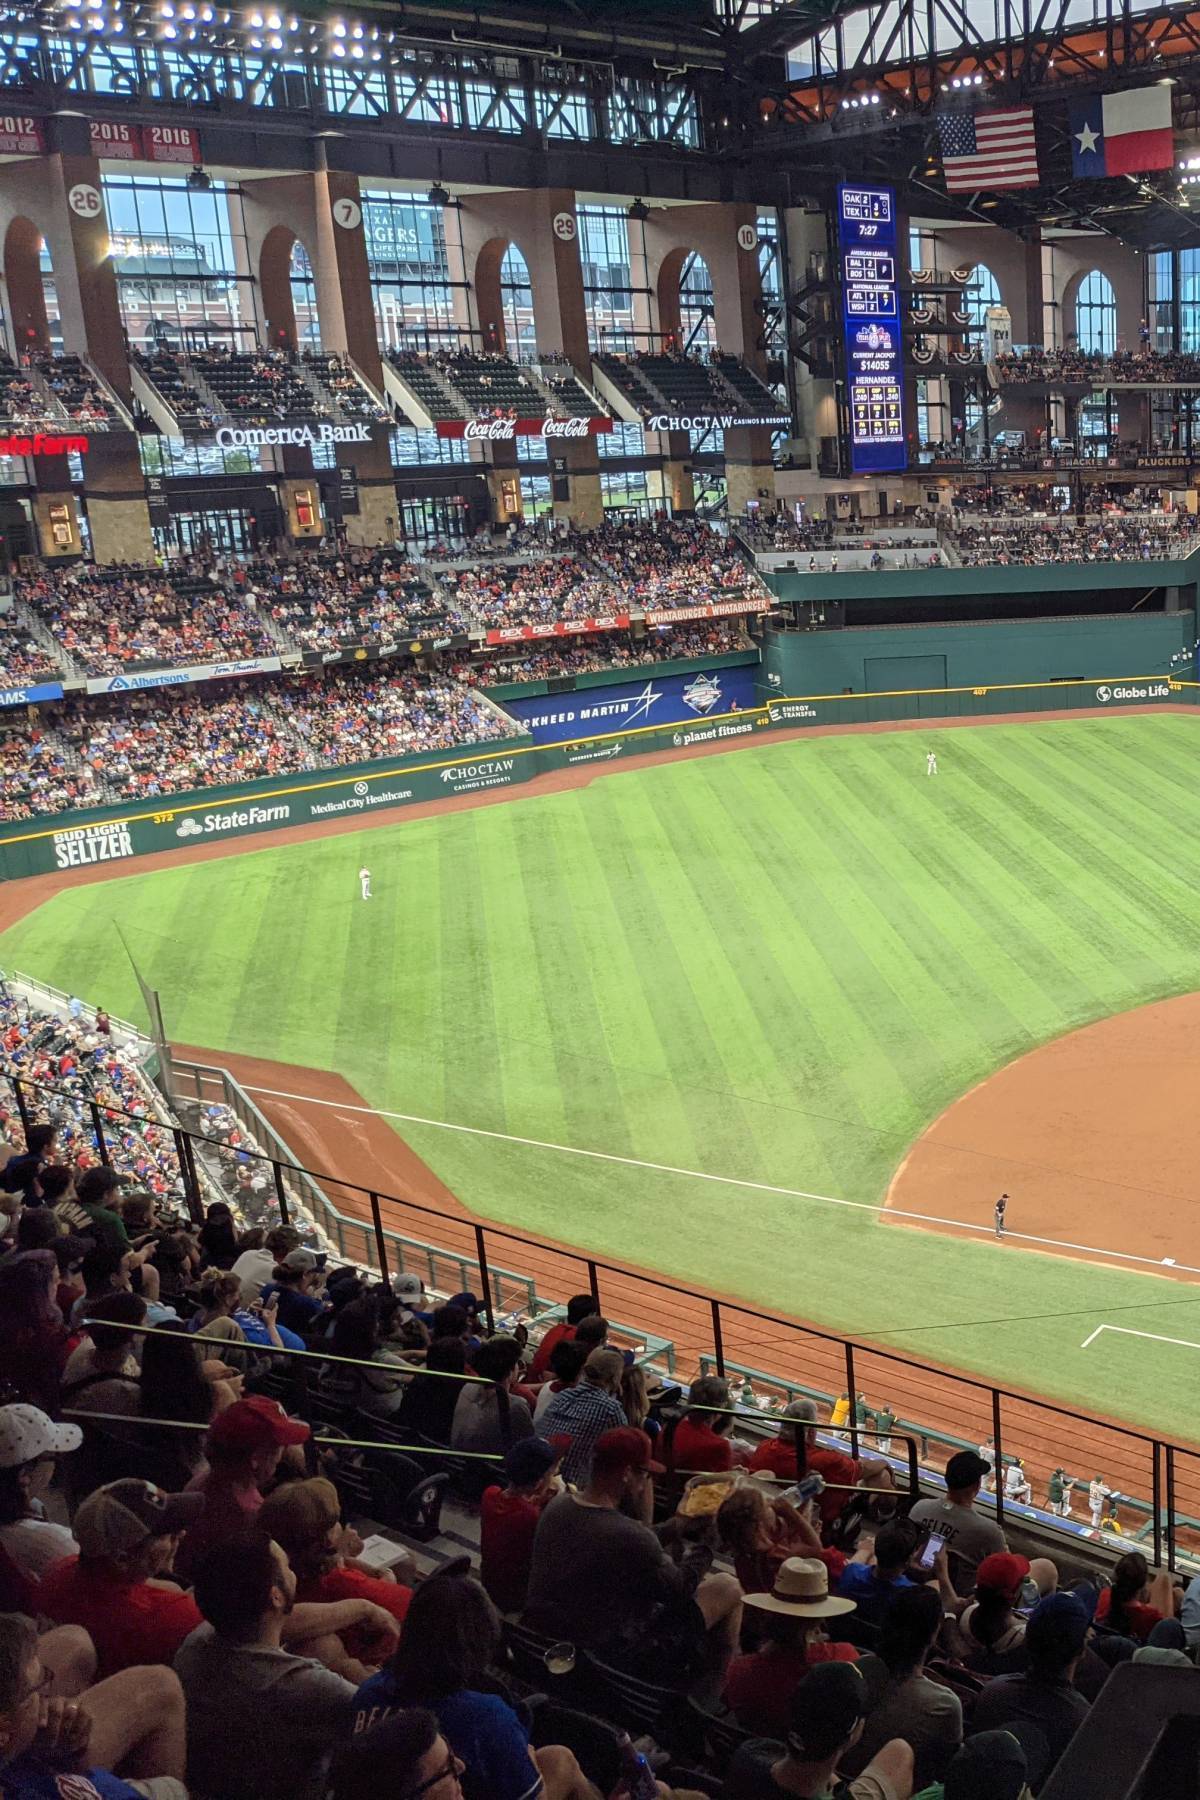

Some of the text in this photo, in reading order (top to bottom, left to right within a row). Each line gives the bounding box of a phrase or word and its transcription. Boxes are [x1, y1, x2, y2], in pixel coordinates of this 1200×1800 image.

[91, 123, 129, 141] 2015
[152, 127, 190, 145] 2016
[73, 191, 99, 210] 26
[844, 195, 860, 204] OAK
[341, 206, 354, 222] 7
[846, 208, 860, 216] TEX
[555, 218, 574, 236] 29
[859, 225, 877, 235] 7:27
[741, 230, 754, 245] 10
[860, 360, 890, 371] $14055
[856, 376, 896, 385] HERNANDEZ
[464, 419, 516, 441] Coca-Cola
[542, 417, 590, 437] Coca-Cola
[657, 415, 732, 431] CHOCTAW
[318, 423, 372, 443] Bank
[1138, 458, 1191, 467] PLUCKERS
[649, 601, 767, 623] WHATABURGER WHATABURGER
[532, 623, 555, 634] DEX
[564, 620, 586, 631] DEX
[595, 617, 616, 628] DEX
[500, 626, 523, 638] DEX
[213, 661, 262, 675] Tom Thumb
[131, 671, 189, 689] Albertsons
[1113, 685, 1169, 700] Globe Life
[580, 703, 629, 719] MARTIN
[782, 706, 809, 714] ENERGY
[783, 711, 816, 719] TRANSFER
[757, 717, 769, 726] 410
[684, 722, 752, 746] planet fitness
[448, 760, 513, 780] CHOCTAW
[454, 776, 511, 791] CASINOS RESORTS
[311, 789, 412, 815] Medical City Healthcare
[153, 813, 174, 824] 372
[53, 822, 129, 844] BUD LIGHT
[55, 831, 133, 869] SELTZER
